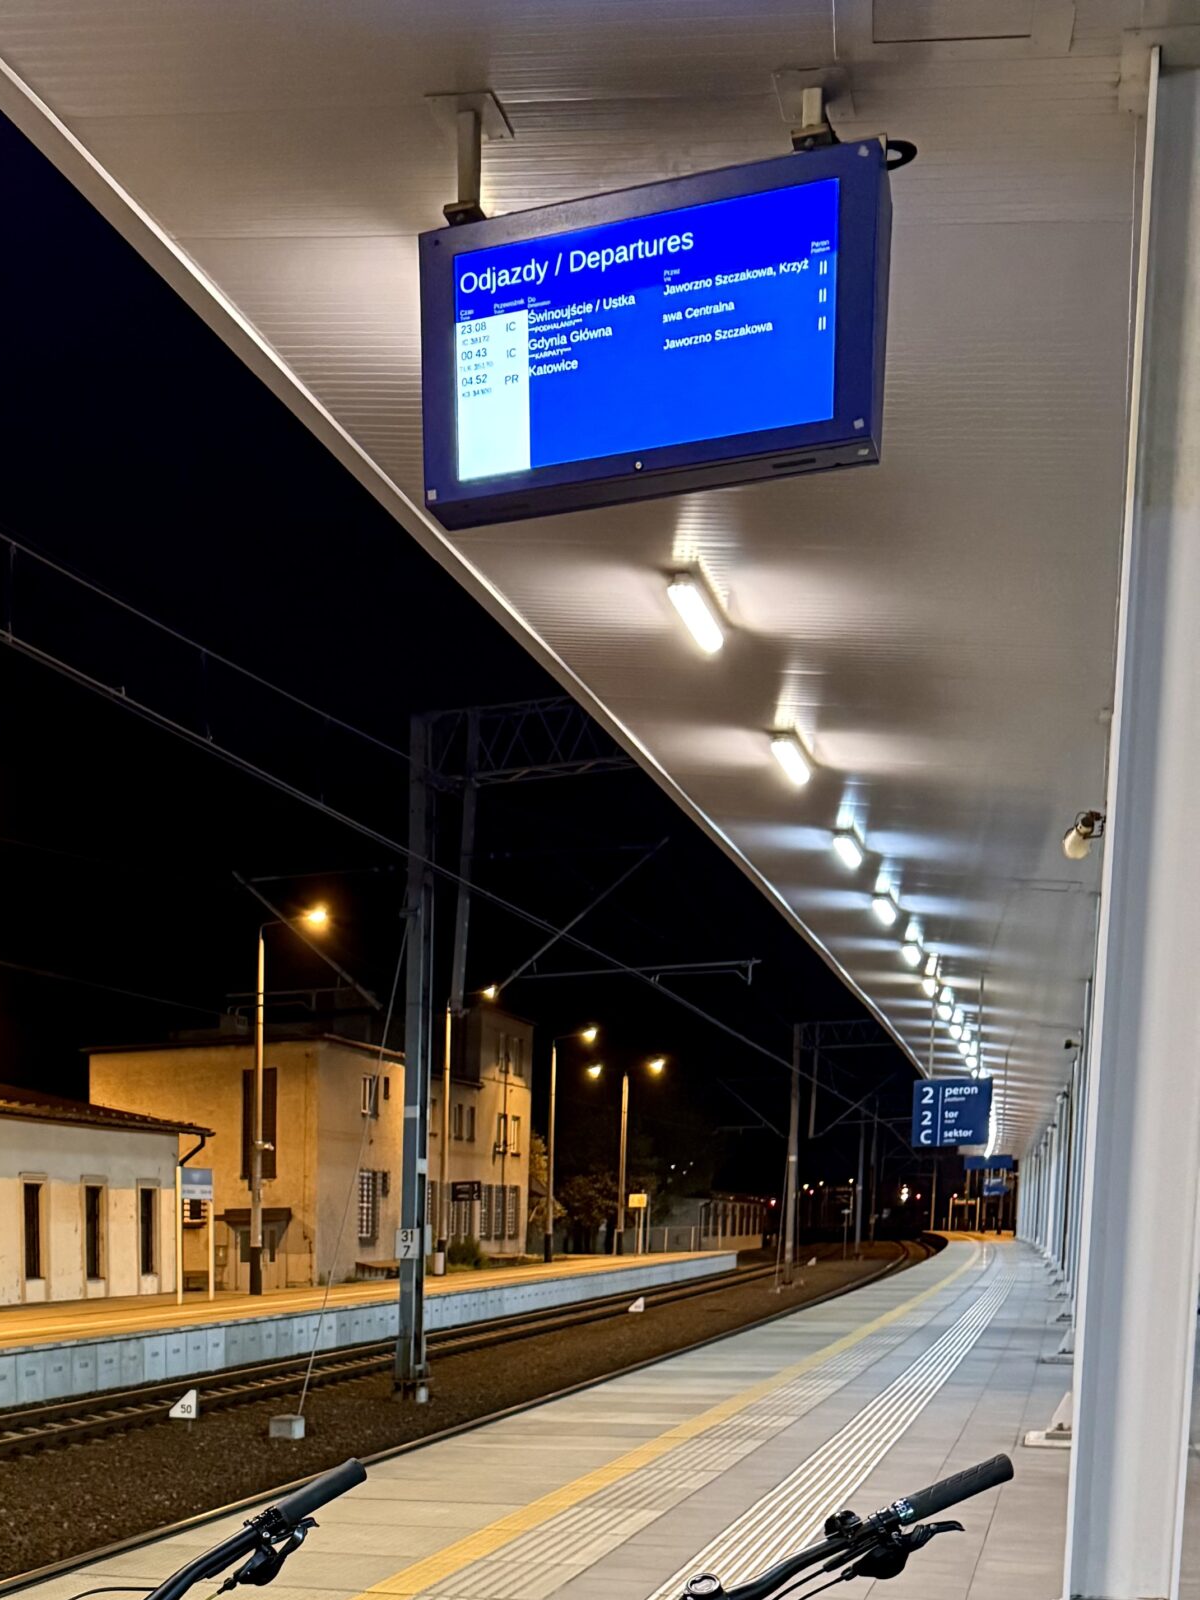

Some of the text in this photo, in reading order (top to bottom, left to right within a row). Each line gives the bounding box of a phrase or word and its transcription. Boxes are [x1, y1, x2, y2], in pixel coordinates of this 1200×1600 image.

[460, 232, 694, 294] Odjazdy / Departures
[664, 258, 809, 296] Jaworzno Szczakowa, Krzyż
[528, 302, 593, 324] Świnoujście
[603, 294, 636, 310] Ustka
[685, 300, 735, 319] Centralna
[506, 322, 517, 332] IC
[528, 326, 612, 352] Gdynia Główna
[664, 321, 773, 350] Jaworzno Szczakowa
[506, 348, 517, 358] IC
[528, 359, 579, 376] Katowice
[505, 374, 519, 385] PR
[921, 1086, 978, 1104] 2 peron
[921, 1111, 932, 1126] 2
[944, 1110, 959, 1118] tor
[920, 1129, 932, 1144] C
[943, 1128, 973, 1138] sektor
[401, 1230, 414, 1242] 31
[403, 1245, 411, 1257] 7
[180, 1403, 192, 1414] 50
